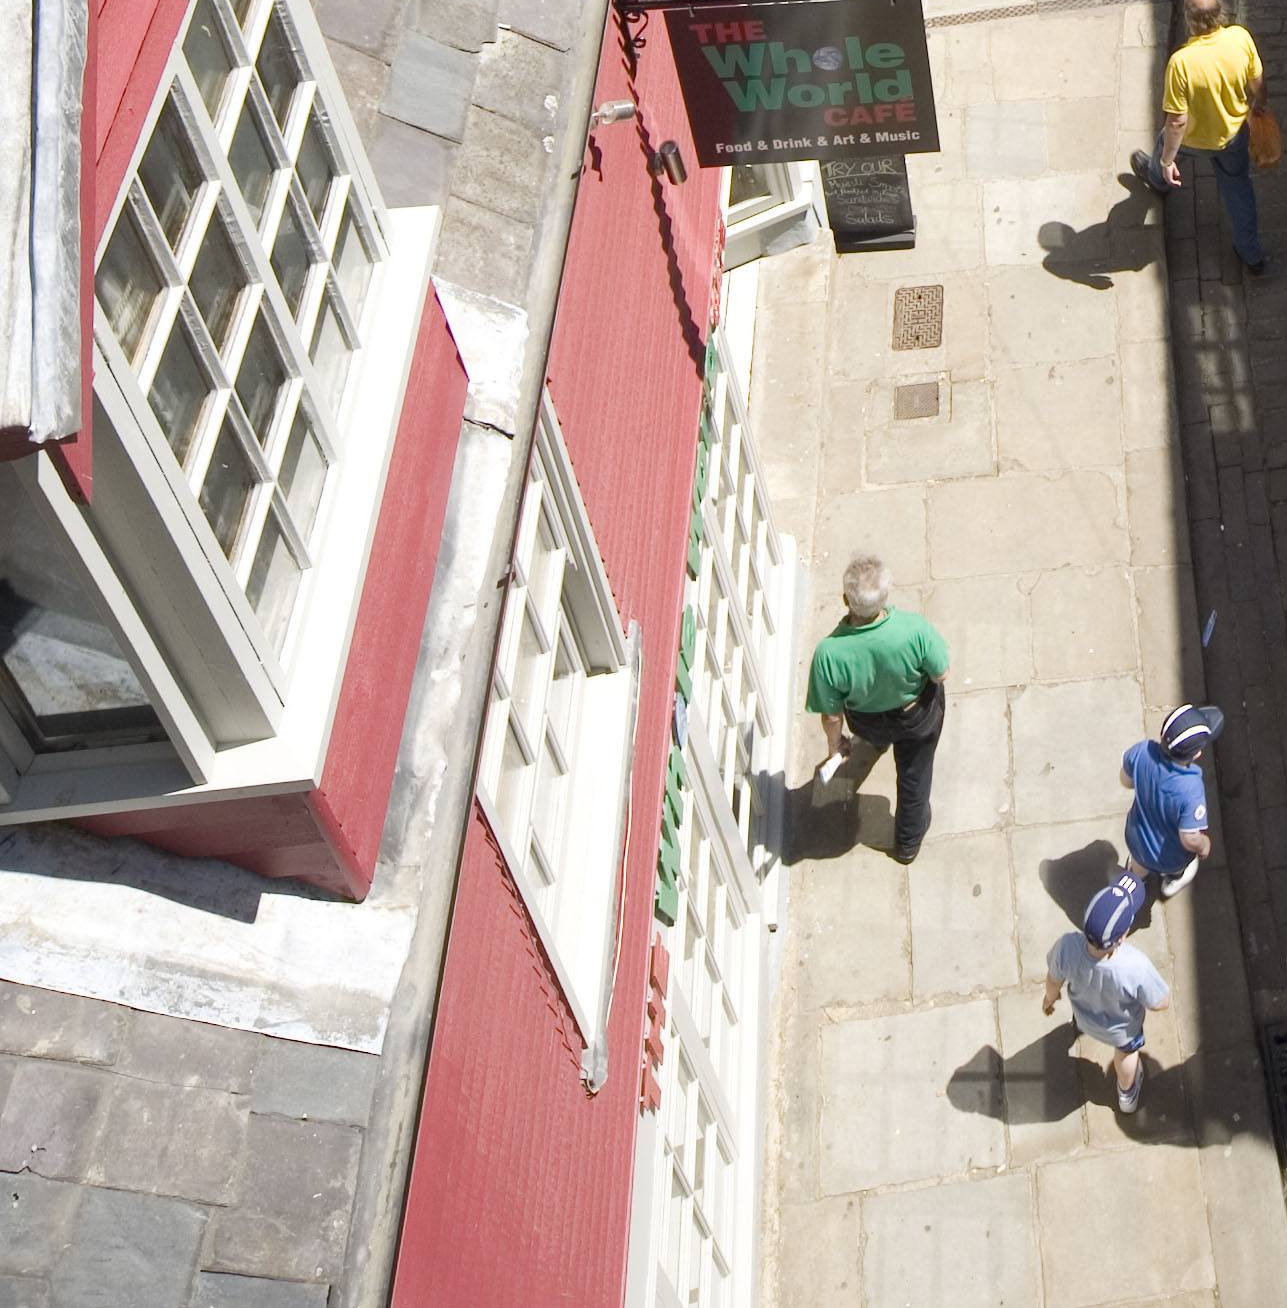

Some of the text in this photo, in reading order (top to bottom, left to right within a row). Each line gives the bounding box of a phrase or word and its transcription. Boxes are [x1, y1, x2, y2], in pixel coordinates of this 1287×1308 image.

[690, 20, 767, 45] THE
[701, 36, 906, 79] Whole
[723, 69, 915, 113] World
[716, 130, 921, 154] Food & Drink & Art & Music
[821, 161, 856, 177] TRY
